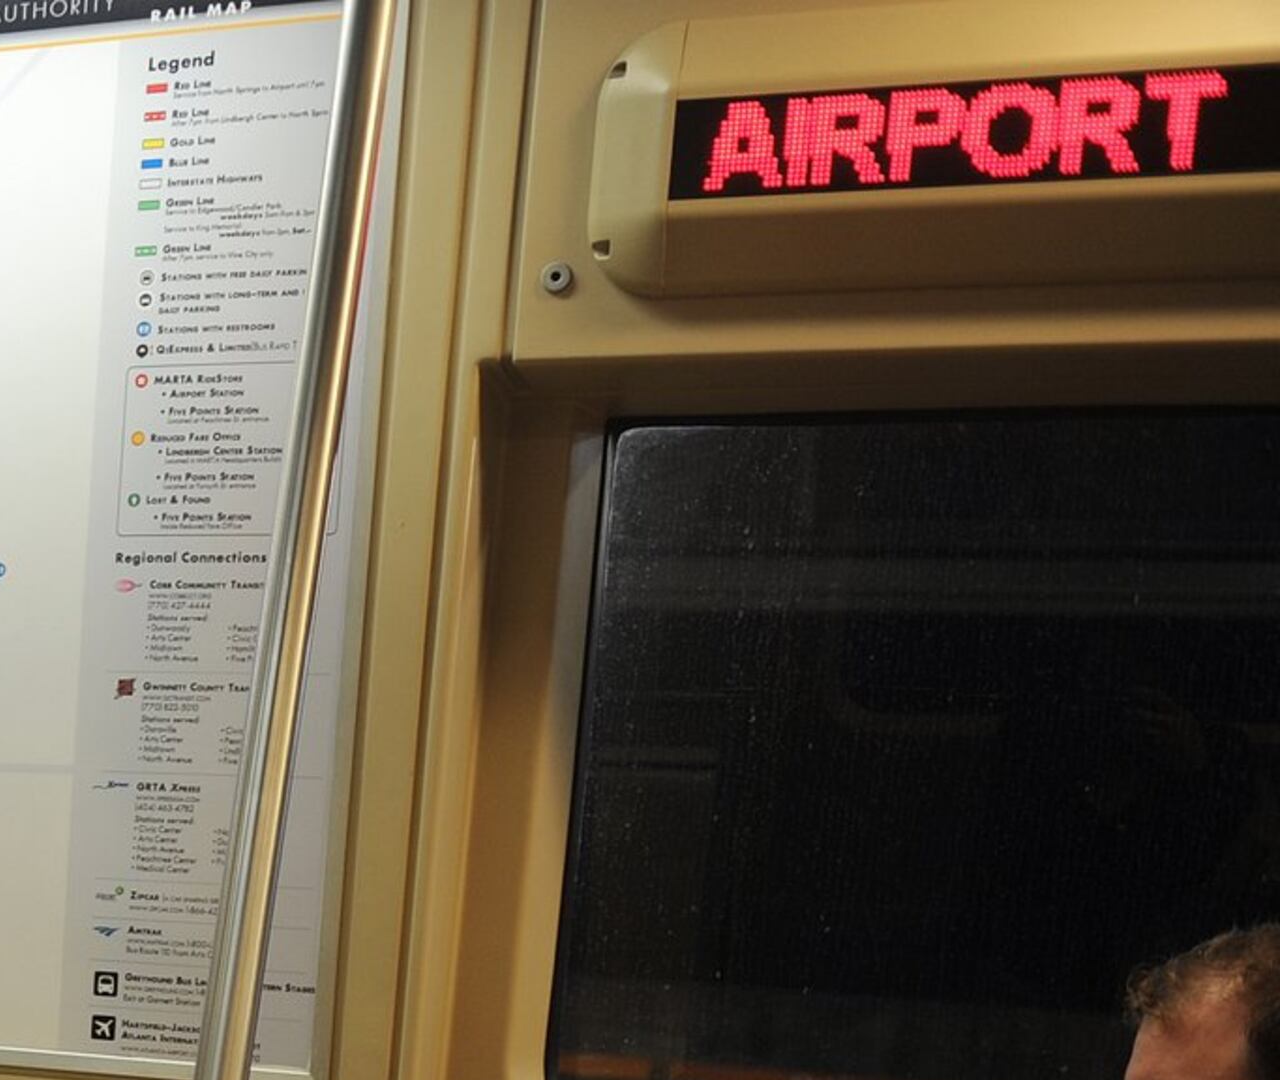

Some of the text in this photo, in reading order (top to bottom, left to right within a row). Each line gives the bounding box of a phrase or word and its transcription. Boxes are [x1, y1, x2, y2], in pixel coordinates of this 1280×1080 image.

[151, 0, 252, 23] RAIL MAP
[149, 51, 215, 74] Legend
[702, 69, 1228, 192] AIRPORT
[154, 375, 193, 384] MARTA
[170, 495, 178, 504] &
[115, 552, 267, 565] Regional Connections
[136, 782, 166, 792] GRTA
